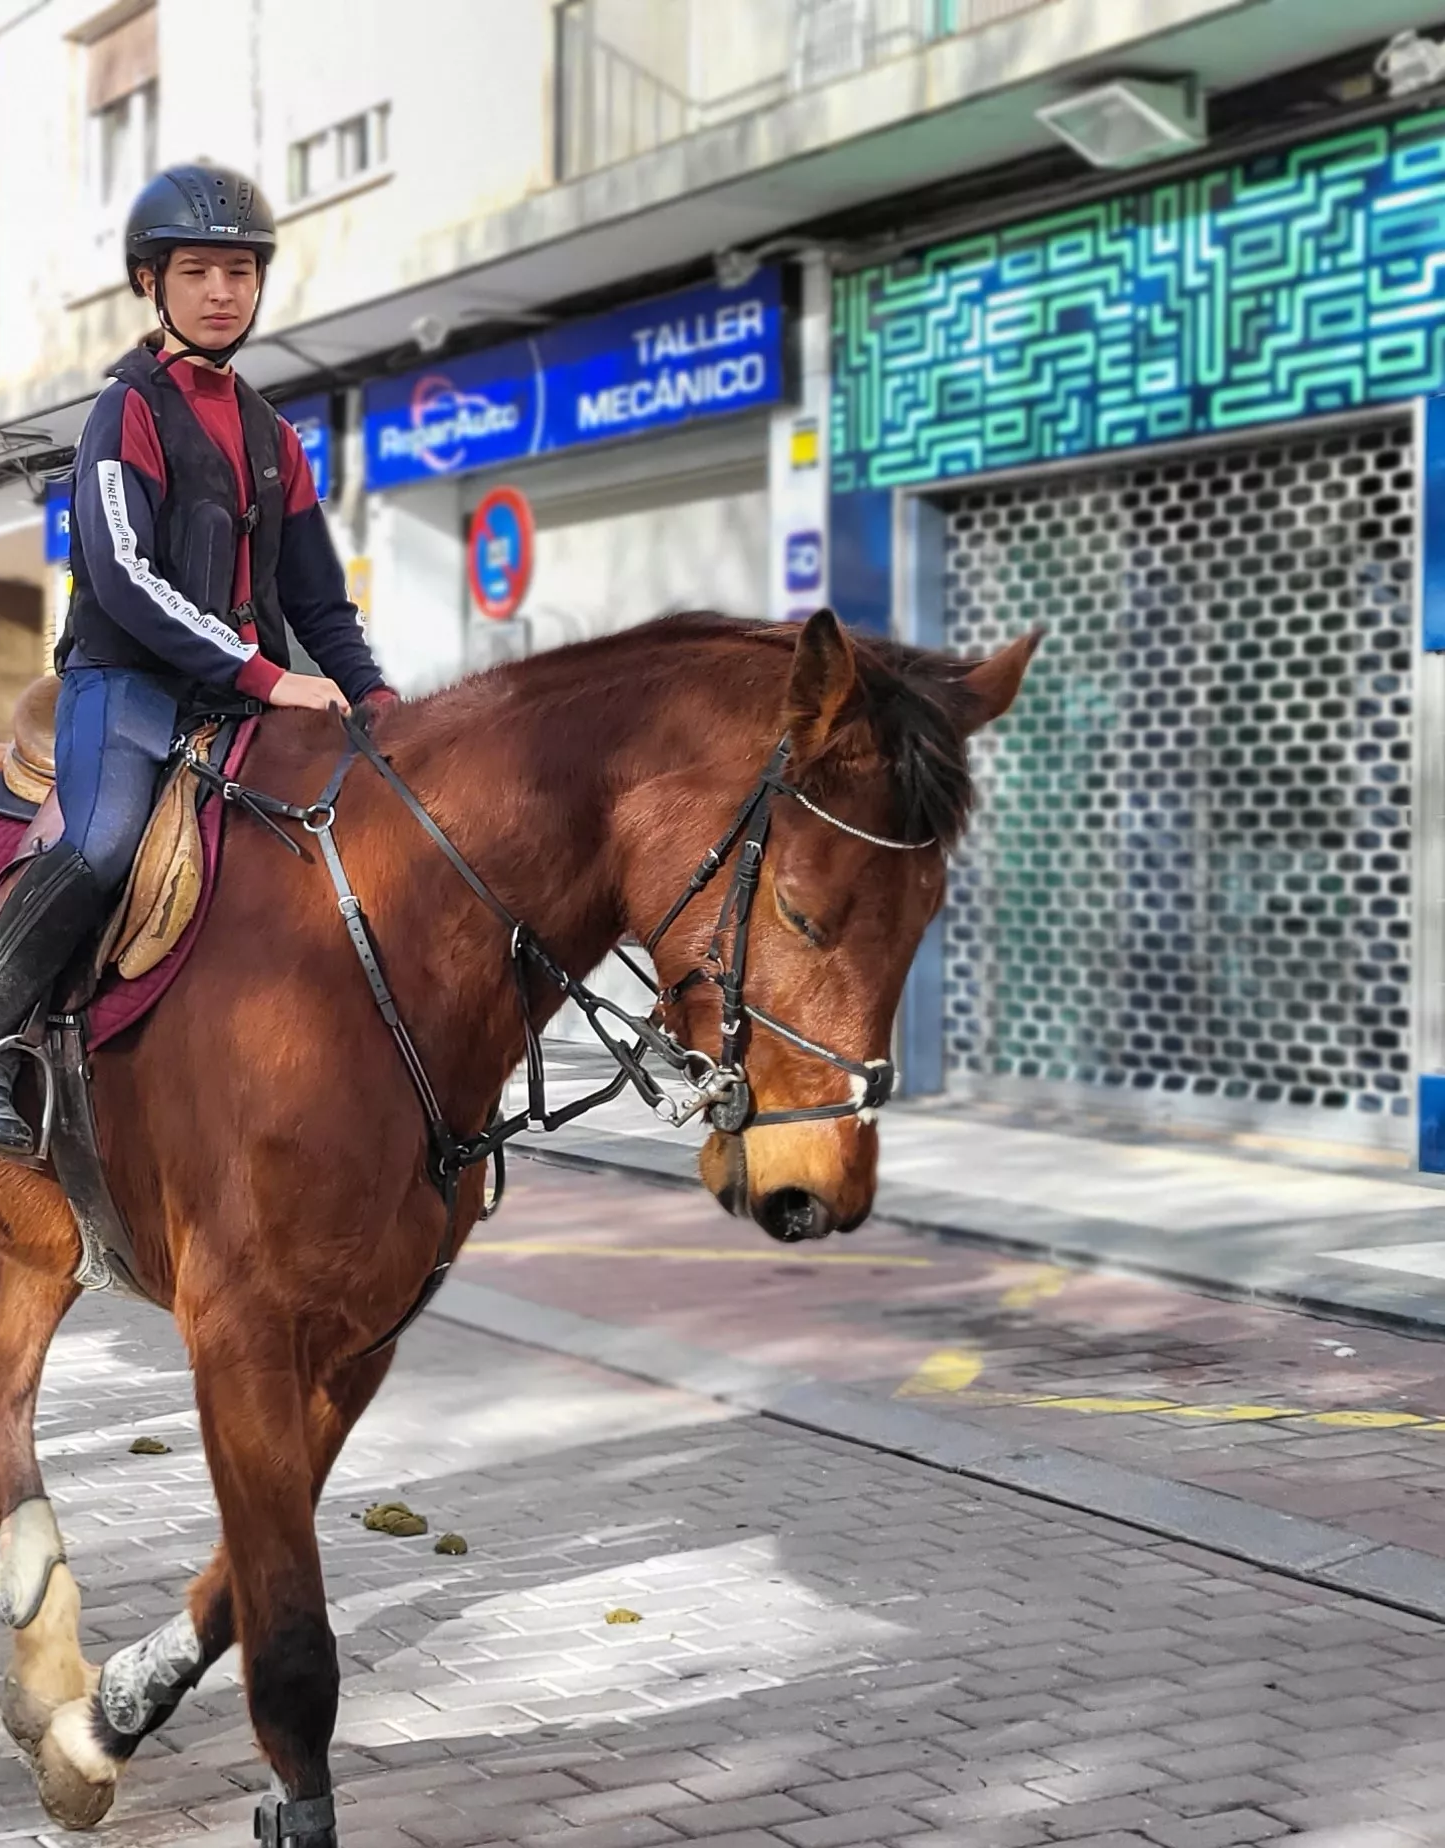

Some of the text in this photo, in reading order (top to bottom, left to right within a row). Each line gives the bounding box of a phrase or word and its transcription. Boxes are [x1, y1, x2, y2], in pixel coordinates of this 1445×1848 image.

[633, 299, 764, 366] TALLER
[577, 353, 766, 422] MECÁNICO
[107, 472, 119, 508] THREE
